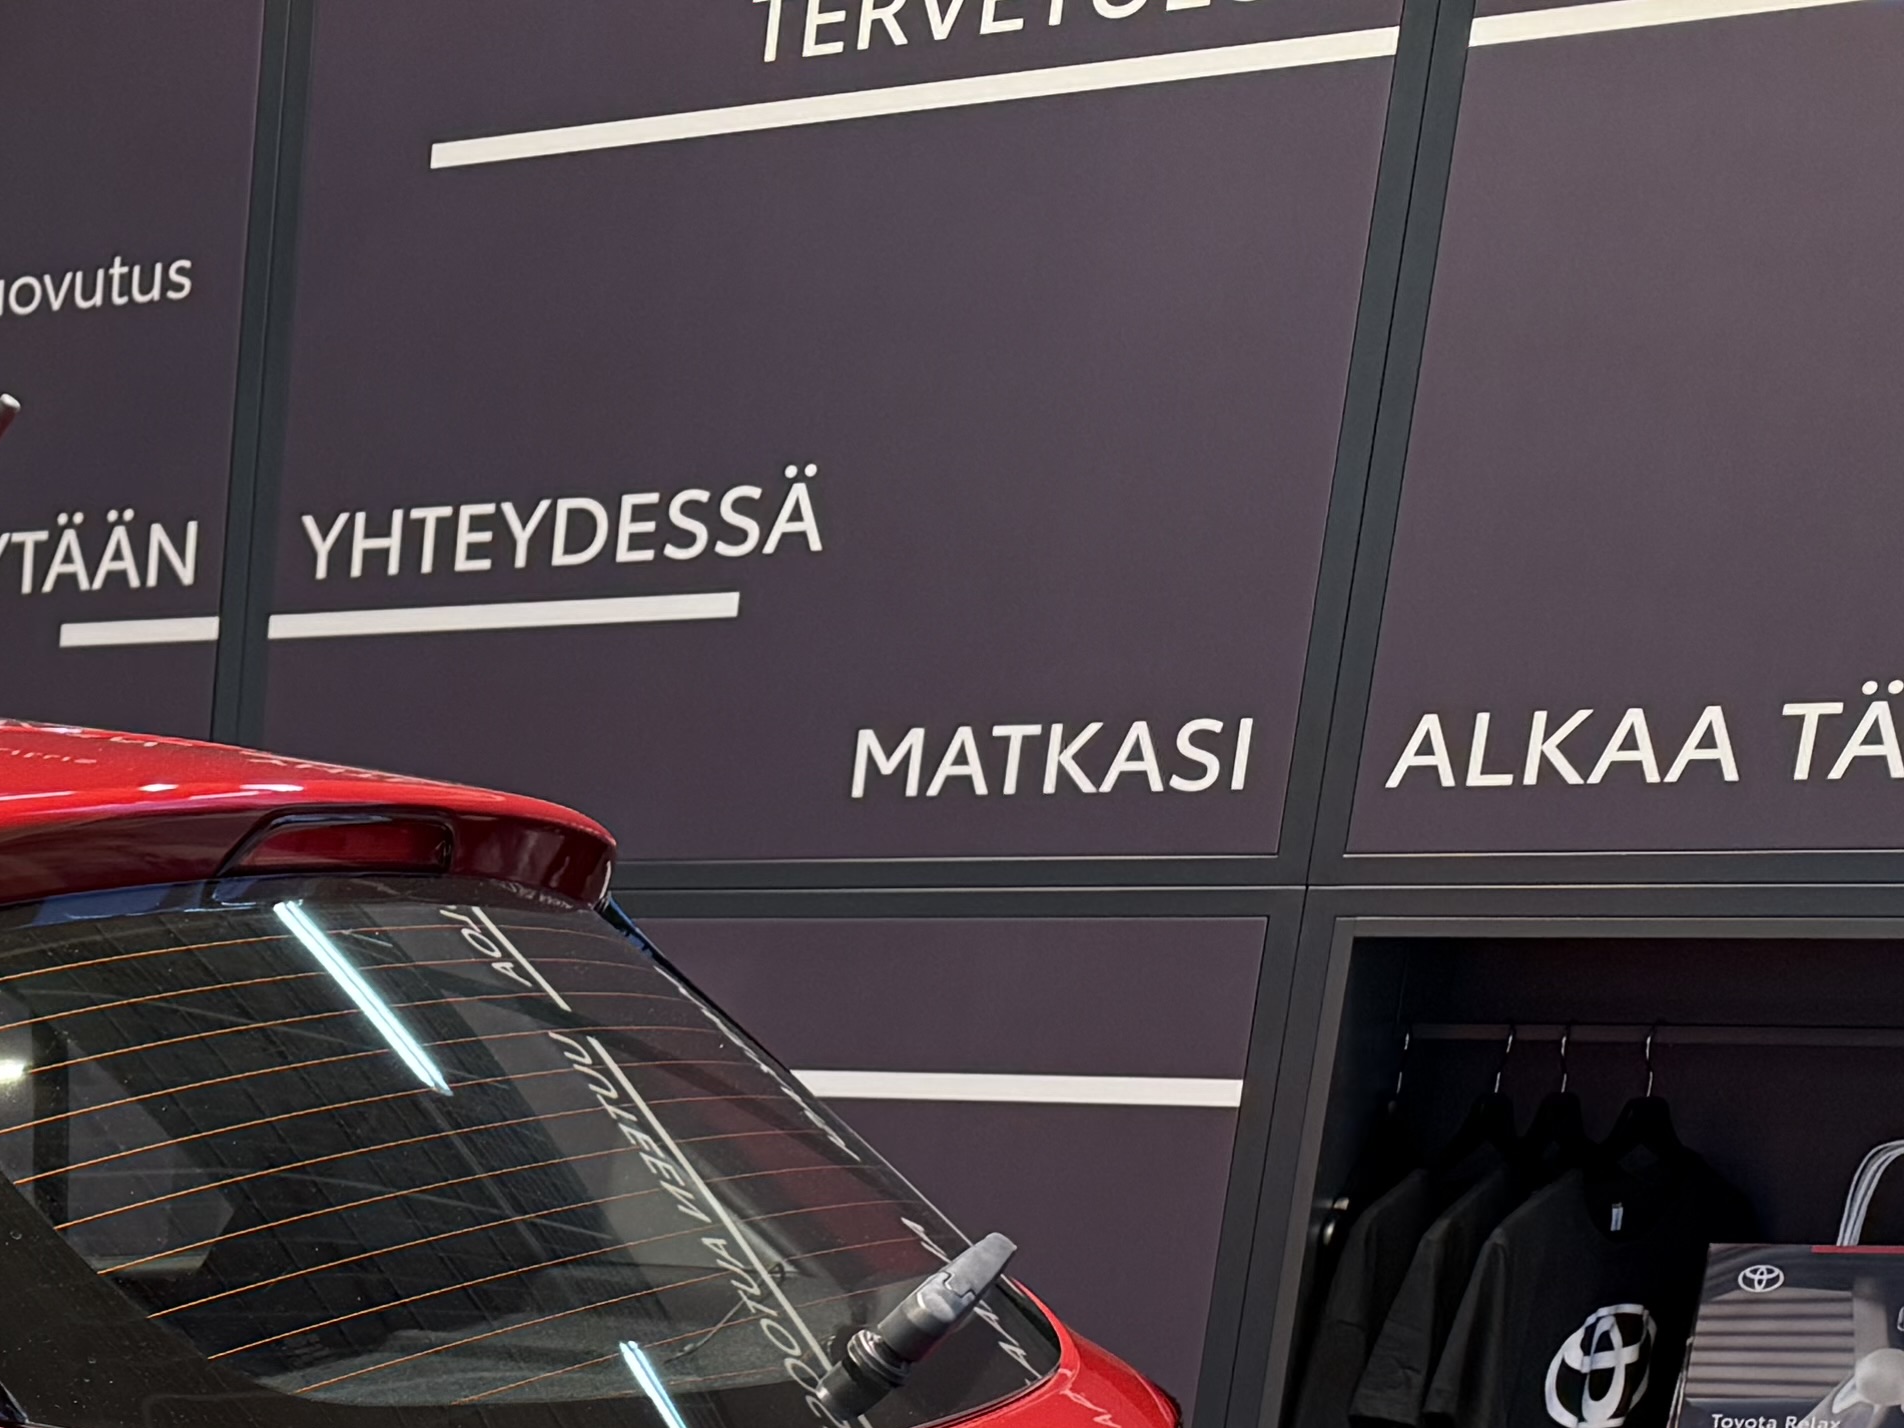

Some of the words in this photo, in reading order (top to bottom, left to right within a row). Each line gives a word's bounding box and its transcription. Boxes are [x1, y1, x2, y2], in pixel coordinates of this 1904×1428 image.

[301, 463, 823, 580] YHTEYDESSÄ
[851, 717, 1253, 798] MATKASI
[1385, 705, 1740, 788] ALKAA
[1782, 679, 1904, 780] TÄ
